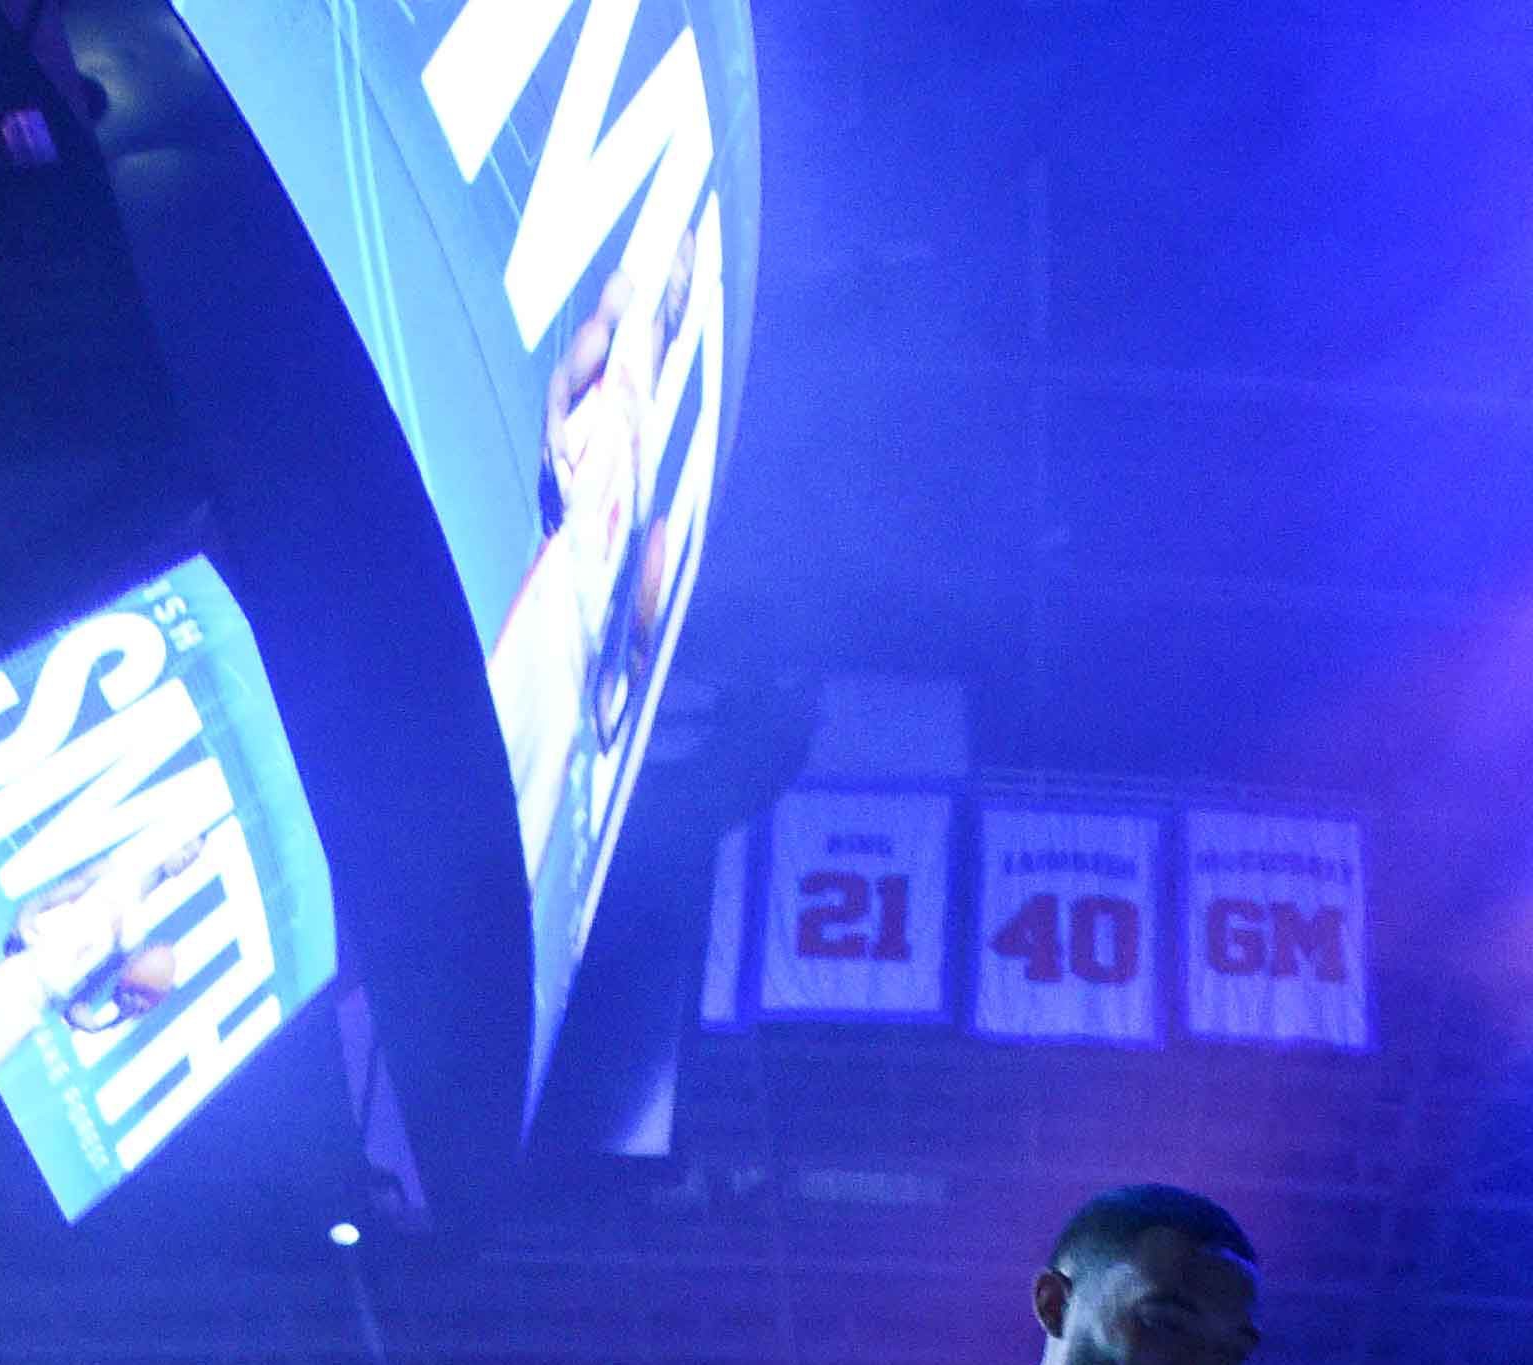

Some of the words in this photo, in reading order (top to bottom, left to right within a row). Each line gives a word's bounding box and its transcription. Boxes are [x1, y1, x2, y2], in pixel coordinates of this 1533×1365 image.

[143, 579, 204, 651] ISH
[797, 870, 912, 962] 21
[989, 892, 1139, 984] 40
[1207, 898, 1346, 984] GM
